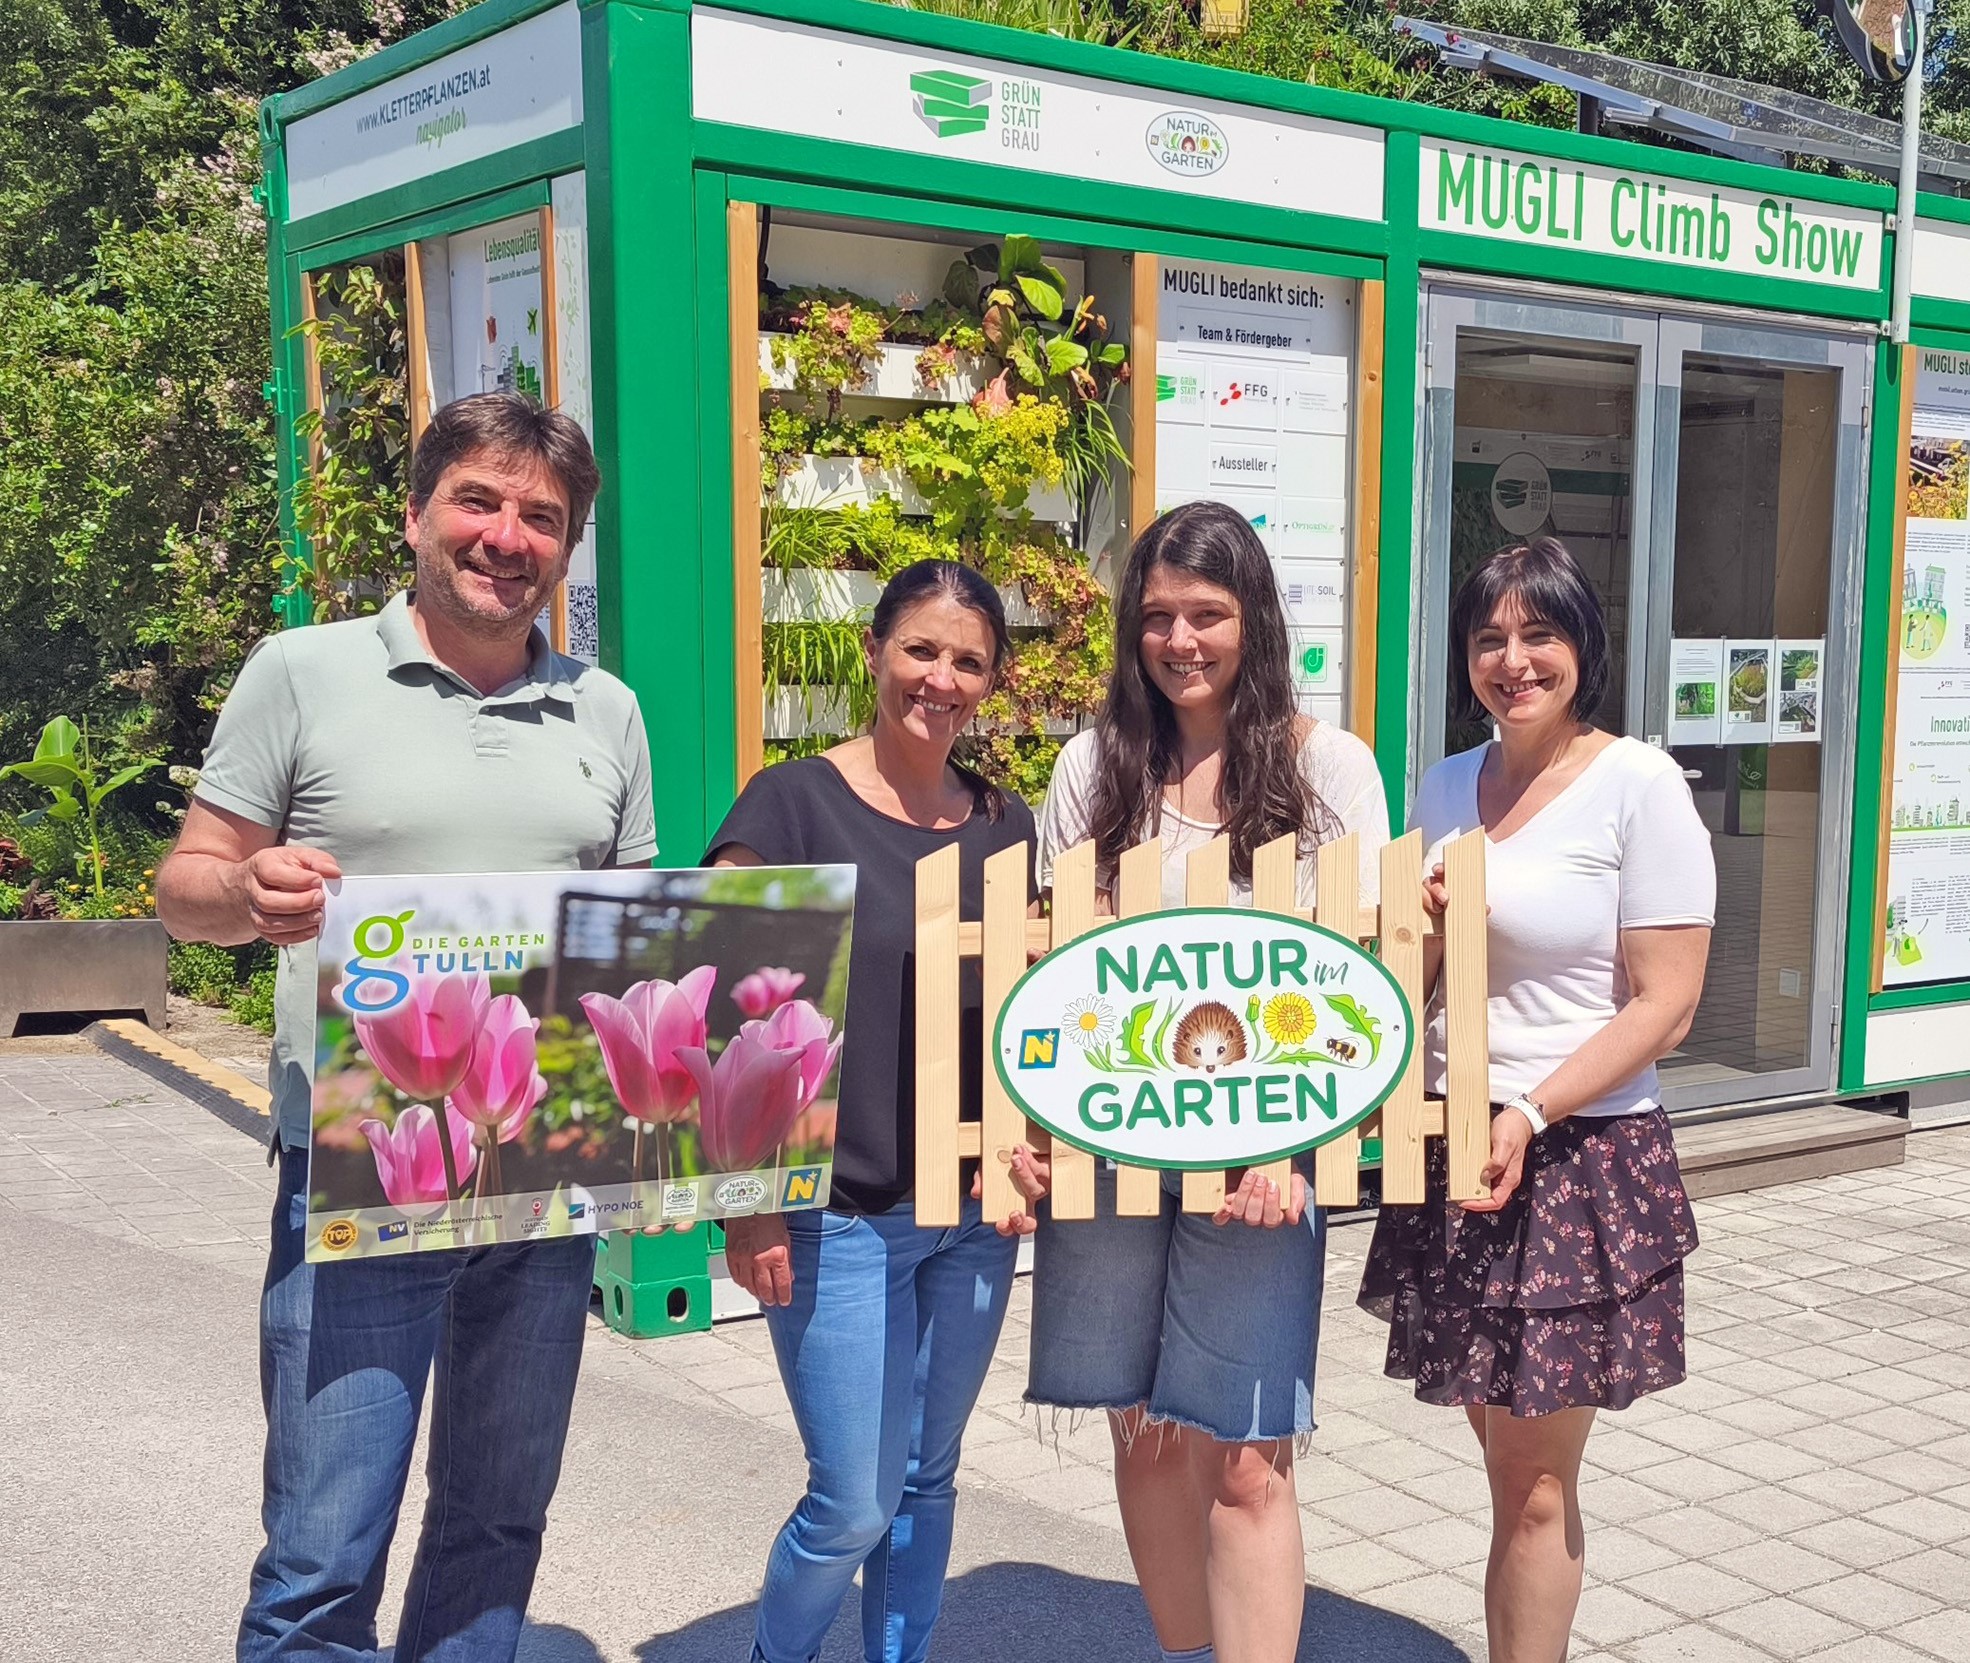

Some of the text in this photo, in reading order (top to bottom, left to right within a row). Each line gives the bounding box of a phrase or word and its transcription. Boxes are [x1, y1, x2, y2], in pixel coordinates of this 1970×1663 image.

[356, 64, 491, 133] www.KLETTERPFLANZEN.at
[1001, 80, 1041, 106] GRÜN
[1001, 104, 1041, 129] STATT
[1166, 117, 1210, 136] NATUR
[415, 105, 468, 151] navigator
[1001, 127, 1040, 152] GRAU
[1161, 150, 1214, 170] GARTEN
[1437, 148, 1863, 278] MUGLI Climb Show
[484, 227, 541, 263] Lebensqualität
[1164, 268, 1324, 309] MUGLI bedankt sich:
[1198, 325, 1292, 349] Team & Fördergeber
[1924, 353, 1957, 374] MUGLI
[1180, 375, 1197, 386] GRÜN
[1180, 387, 1197, 395] STATT
[1244, 384, 1268, 397] FFG
[1218, 456, 1268, 471] Aussteller
[413, 933, 545, 949] DIE GARTEN
[412, 950, 523, 974] TULLN
[1095, 939, 1348, 994] NATUR im
[1078, 1072, 1338, 1132] GARTEN
[729, 1180, 755, 1188] NATUR
[588, 1201, 644, 1214] HYPO NOE
[725, 1196, 756, 1205] GARTEN
[328, 1229, 351, 1241] TOP
